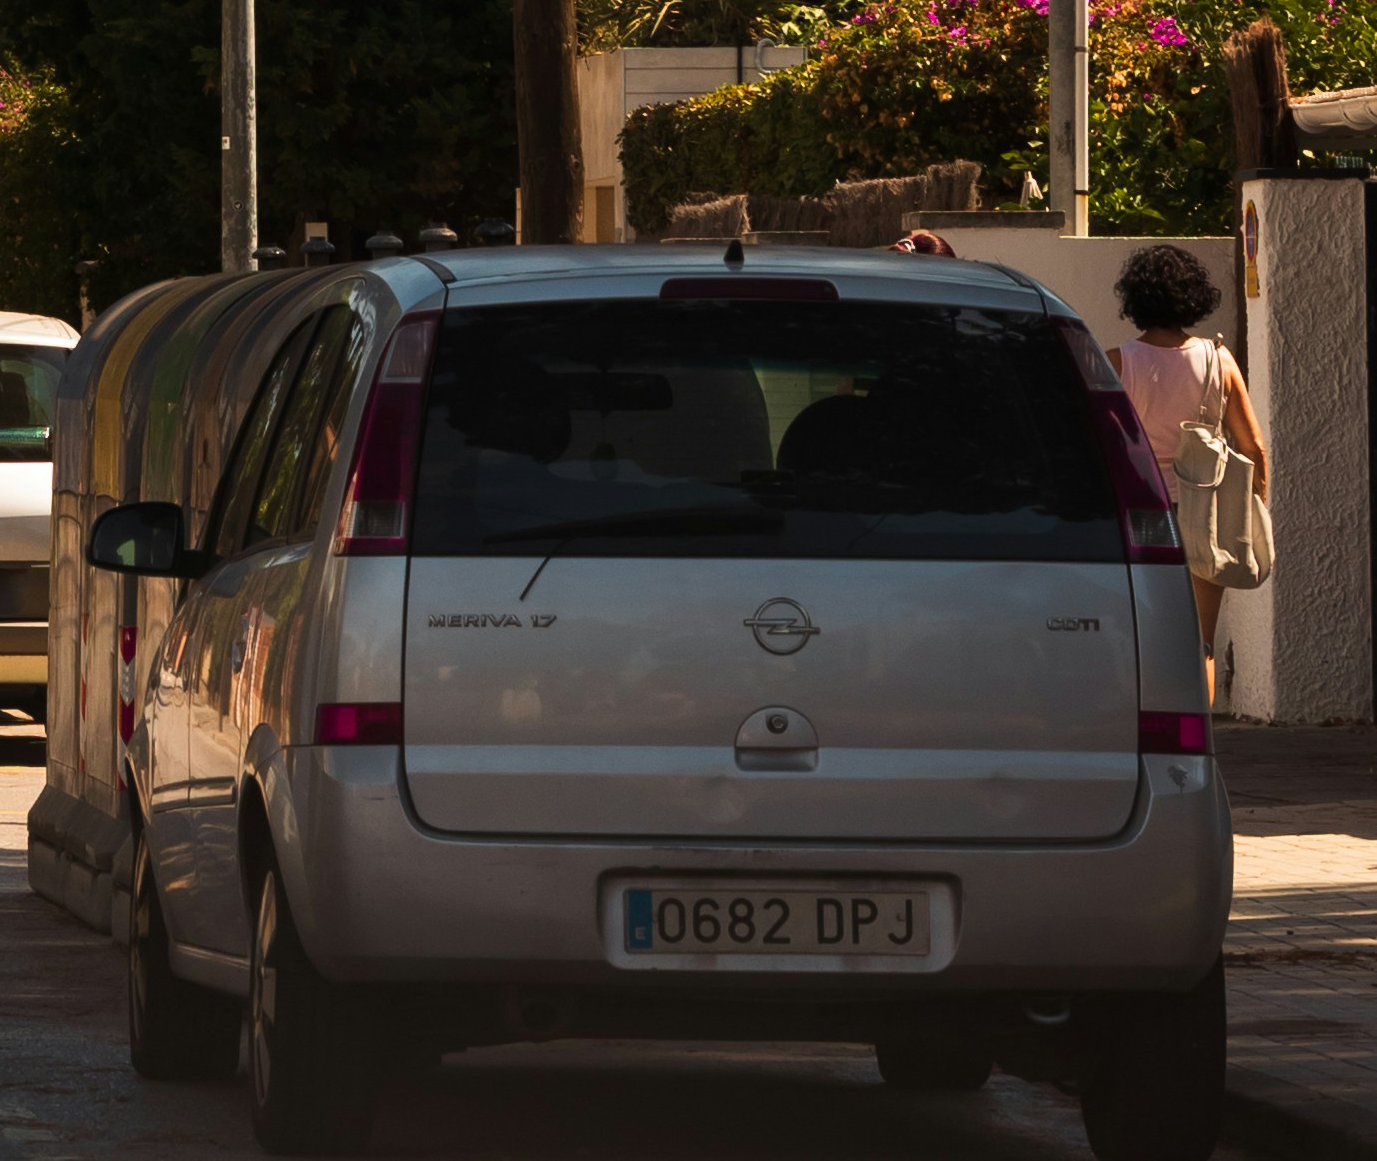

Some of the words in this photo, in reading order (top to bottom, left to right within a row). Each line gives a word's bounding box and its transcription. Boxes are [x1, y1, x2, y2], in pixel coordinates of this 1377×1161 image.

[428, 614, 522, 628] MERIVA
[1046, 617, 1100, 631] CDTI
[657, 897, 791, 945] 0682
[816, 898, 913, 945] DPJ
[634, 927, 647, 940] E
